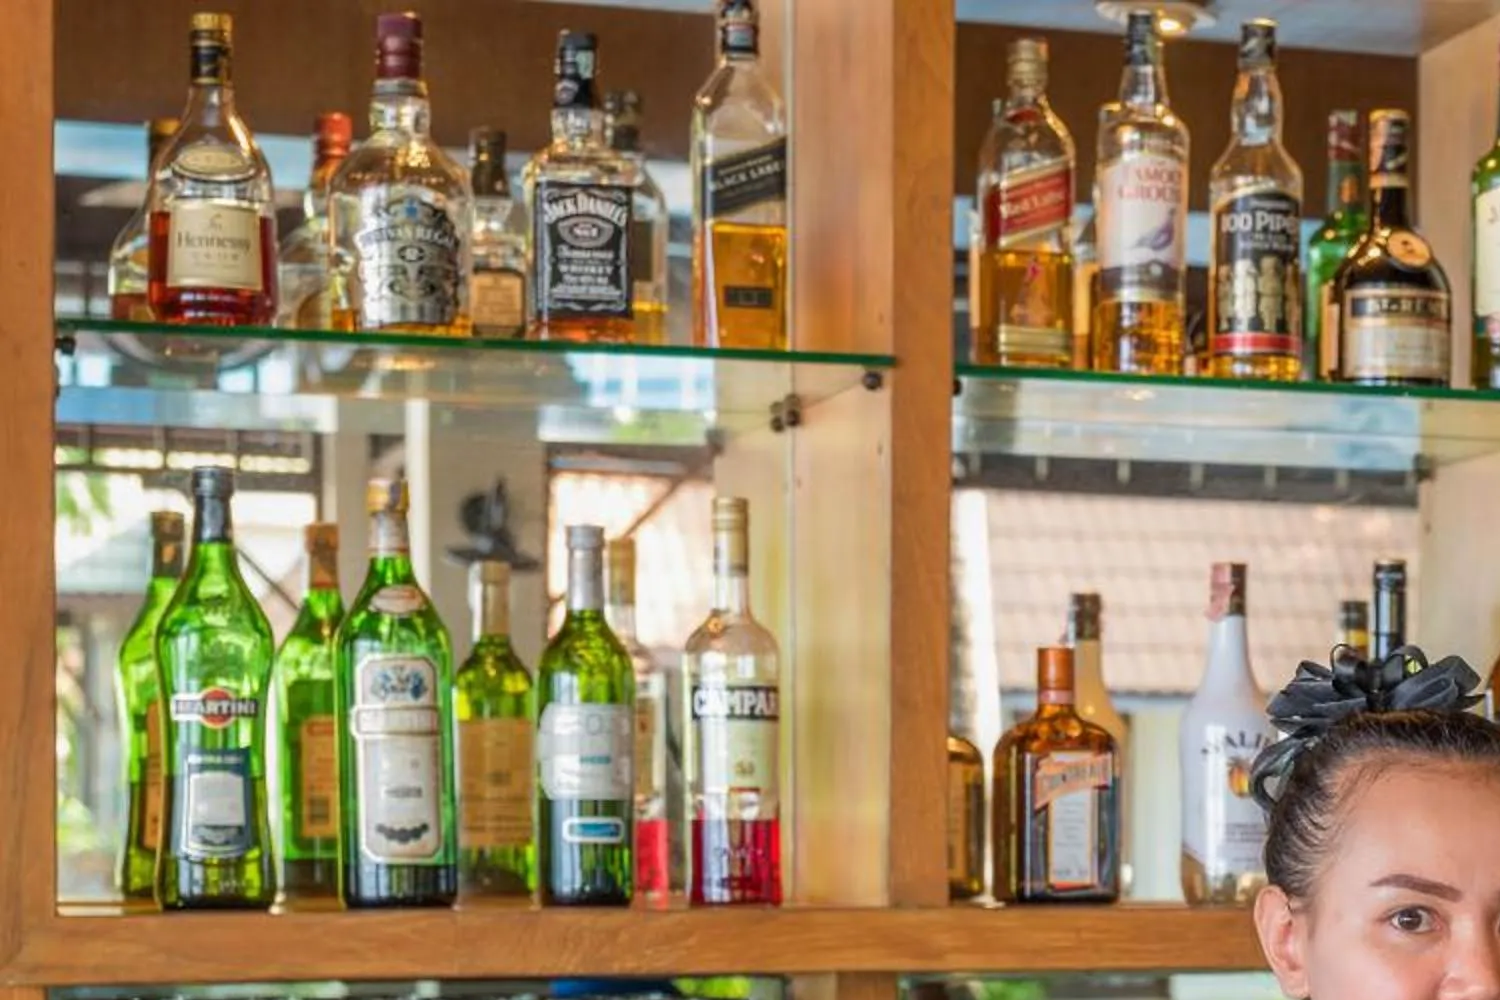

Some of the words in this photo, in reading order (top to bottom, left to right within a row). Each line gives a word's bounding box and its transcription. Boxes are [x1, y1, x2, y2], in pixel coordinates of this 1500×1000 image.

[543, 197, 577, 225] JACK
[1221, 211, 1253, 233] 100
[175, 699, 257, 716] MARTINI
